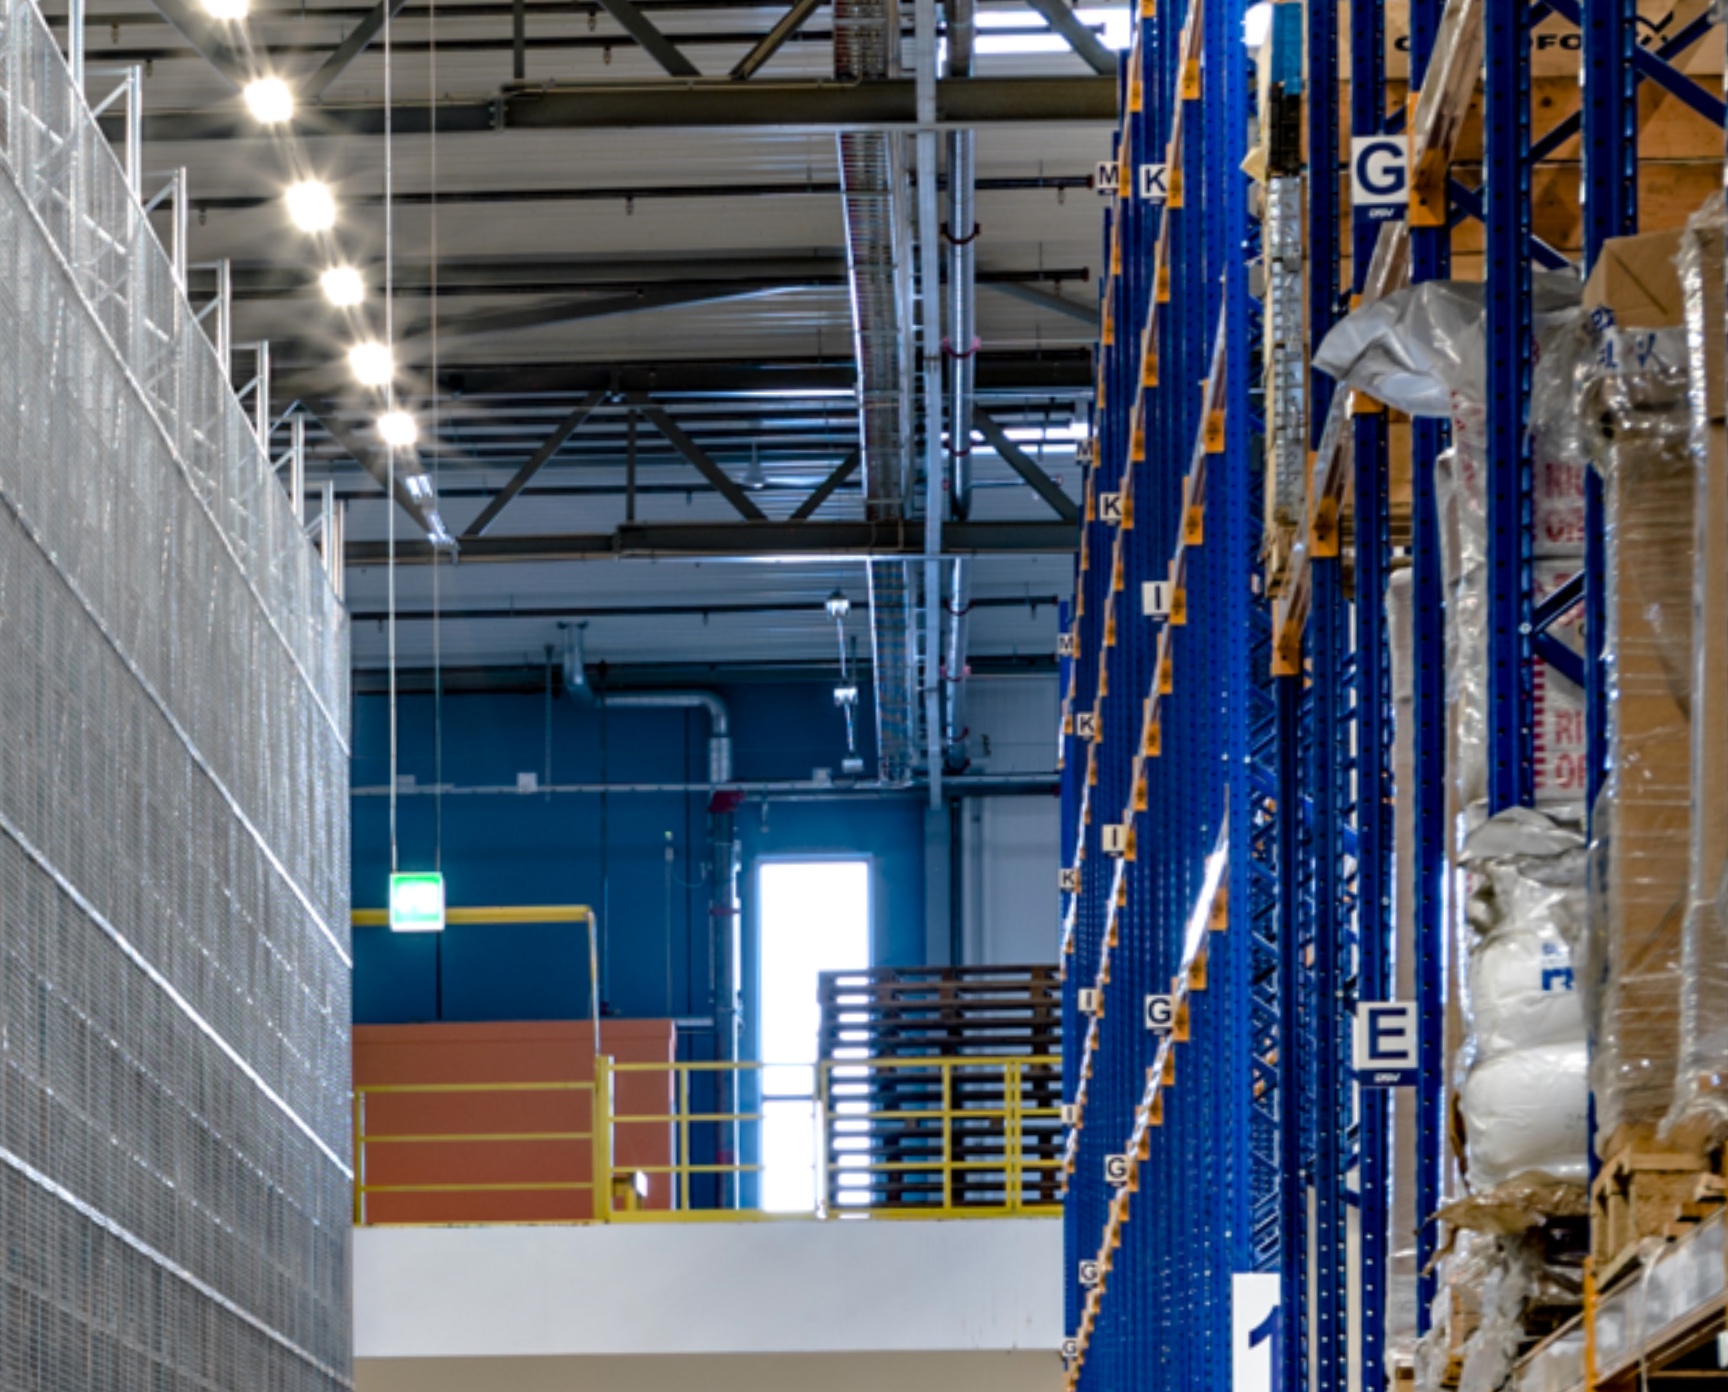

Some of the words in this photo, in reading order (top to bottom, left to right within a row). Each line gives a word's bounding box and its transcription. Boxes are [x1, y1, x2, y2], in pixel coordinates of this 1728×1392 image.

[1145, 167, 1166, 194] K
[1357, 141, 1405, 196] G
[1104, 496, 1121, 516] K
[1155, 584, 1161, 611] I
[1080, 716, 1093, 732] K
[1148, 998, 1171, 1025] G
[1368, 1008, 1408, 1060] E
[1107, 1158, 1126, 1178] G
[1081, 1263, 1097, 1281] G
